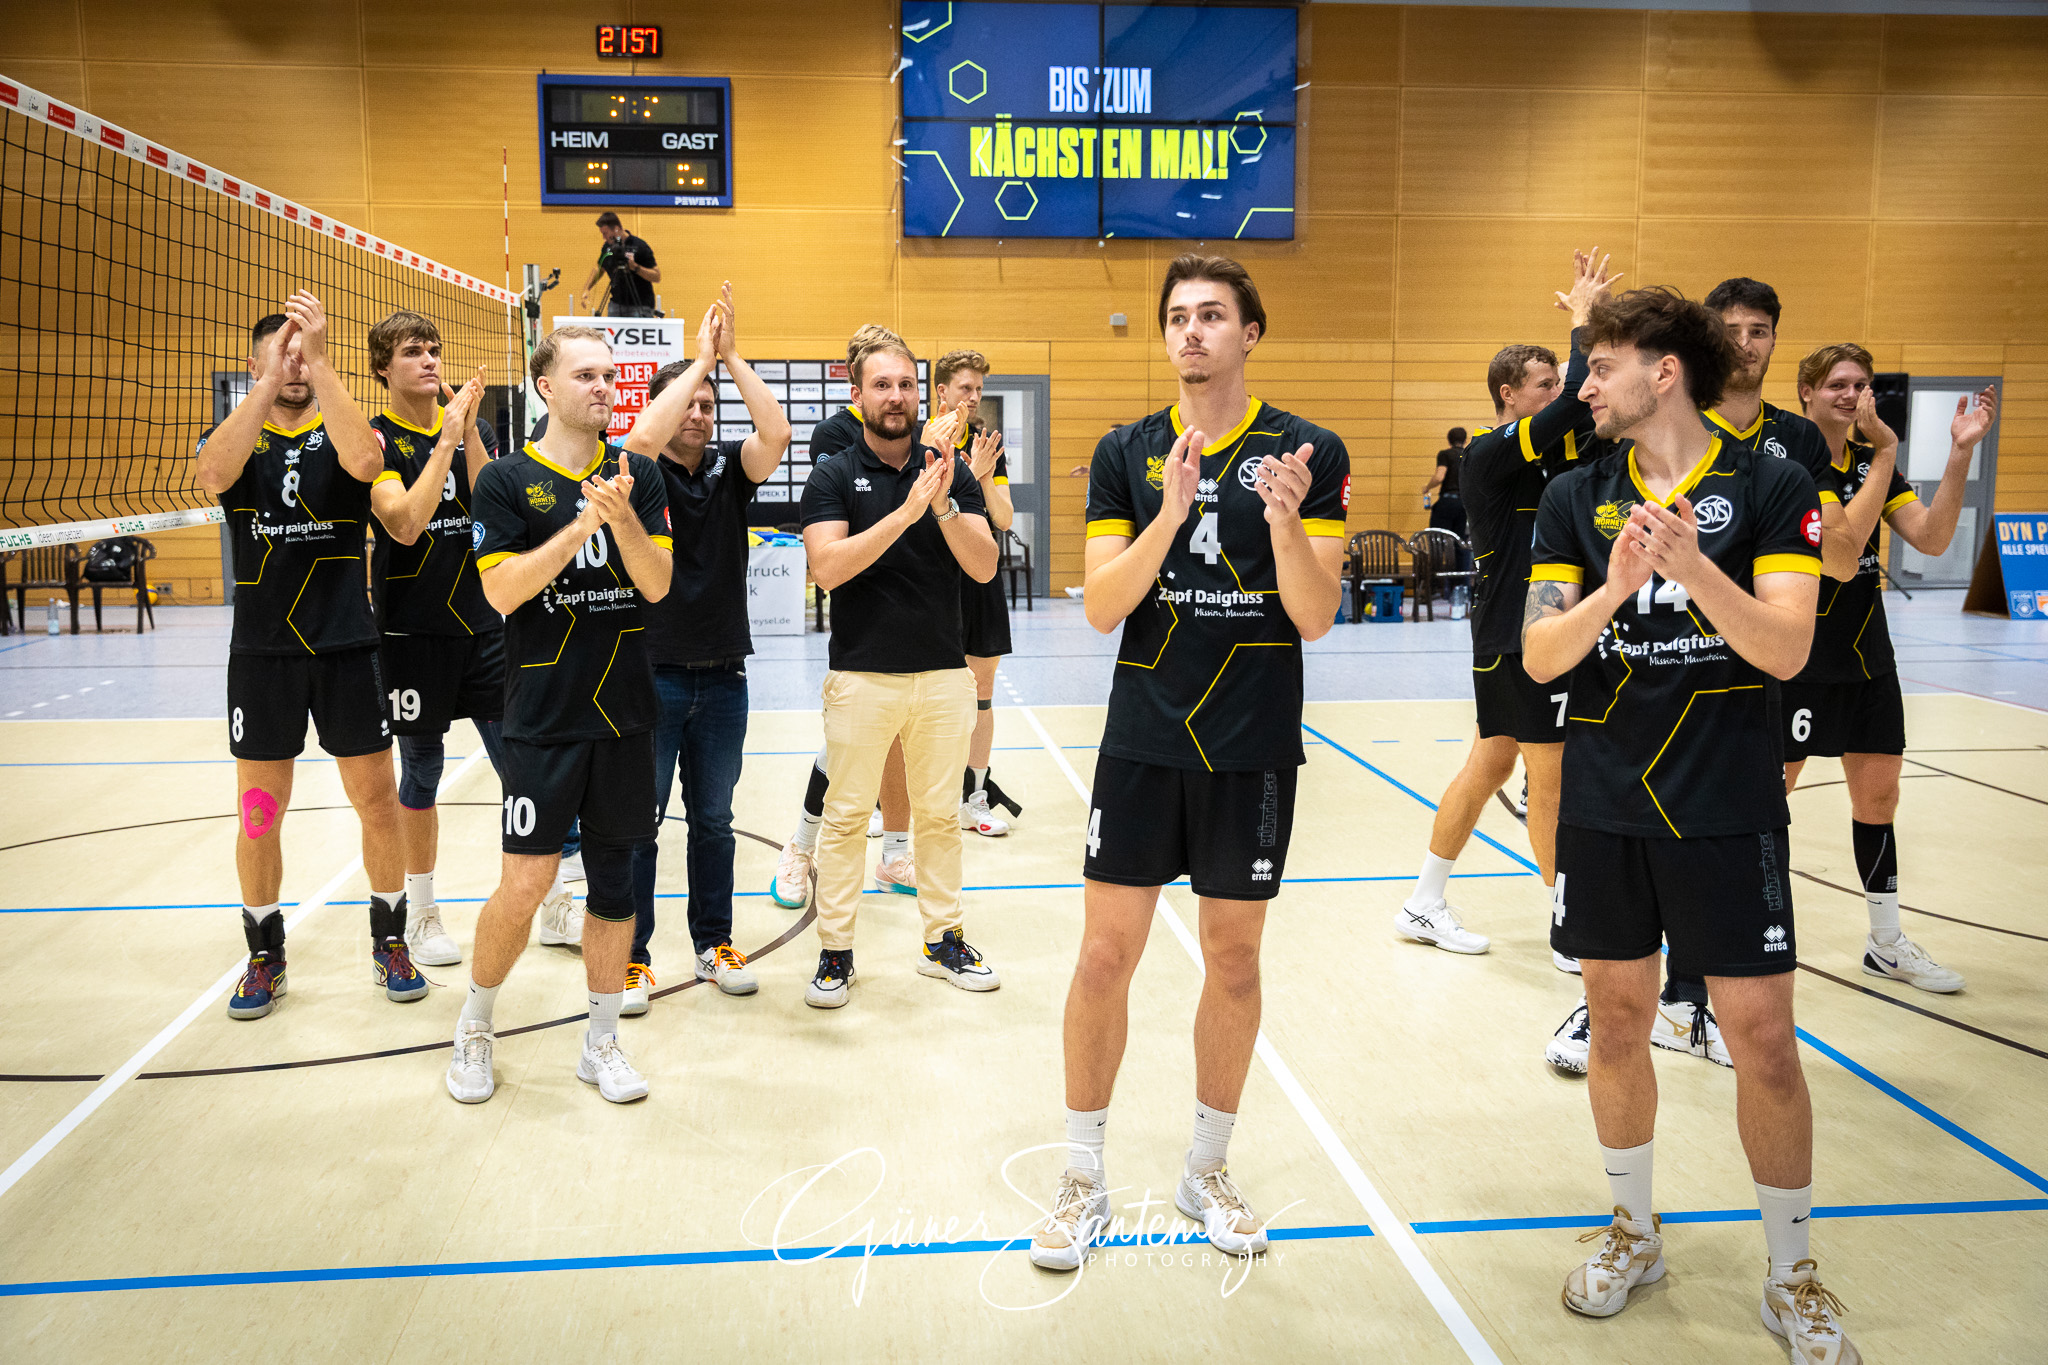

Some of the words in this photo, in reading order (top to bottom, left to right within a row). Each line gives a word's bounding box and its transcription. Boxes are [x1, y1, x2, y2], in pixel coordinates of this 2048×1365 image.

[1048, 66, 1089, 113] BIS
[1094, 67, 1151, 114] ZUM
[551, 131, 609, 148] HEIM
[662, 133, 718, 149] GAST
[1151, 129, 1229, 179] MAL!
[675, 197, 719, 206] PEWETA
[594, 328, 671, 345] YSEL
[613, 349, 671, 358] erbetechnik
[614, 389, 649, 406] APET
[281, 469, 301, 508] 8
[439, 469, 457, 502] 9
[119, 520, 145, 533] FUCHS
[258, 523, 284, 537] Zapf
[425, 518, 442, 531] apf
[1998, 521, 2034, 541] DYN
[2037, 521, 2048, 541] P
[1190, 512, 1221, 564] 4
[2001, 543, 2024, 555] ALLE
[555, 590, 585, 606] Zapf
[1159, 587, 1193, 604] Zapf
[1195, 590, 1264, 607] Daigfuss
[1610, 638, 1650, 656] Zapf
[388, 688, 422, 722] 19
[1550, 692, 1568, 728] 7
[232, 706, 244, 743] 8
[1791, 708, 1812, 742] 6
[504, 795, 537, 837] 10
[1086, 807, 1101, 858] 4
